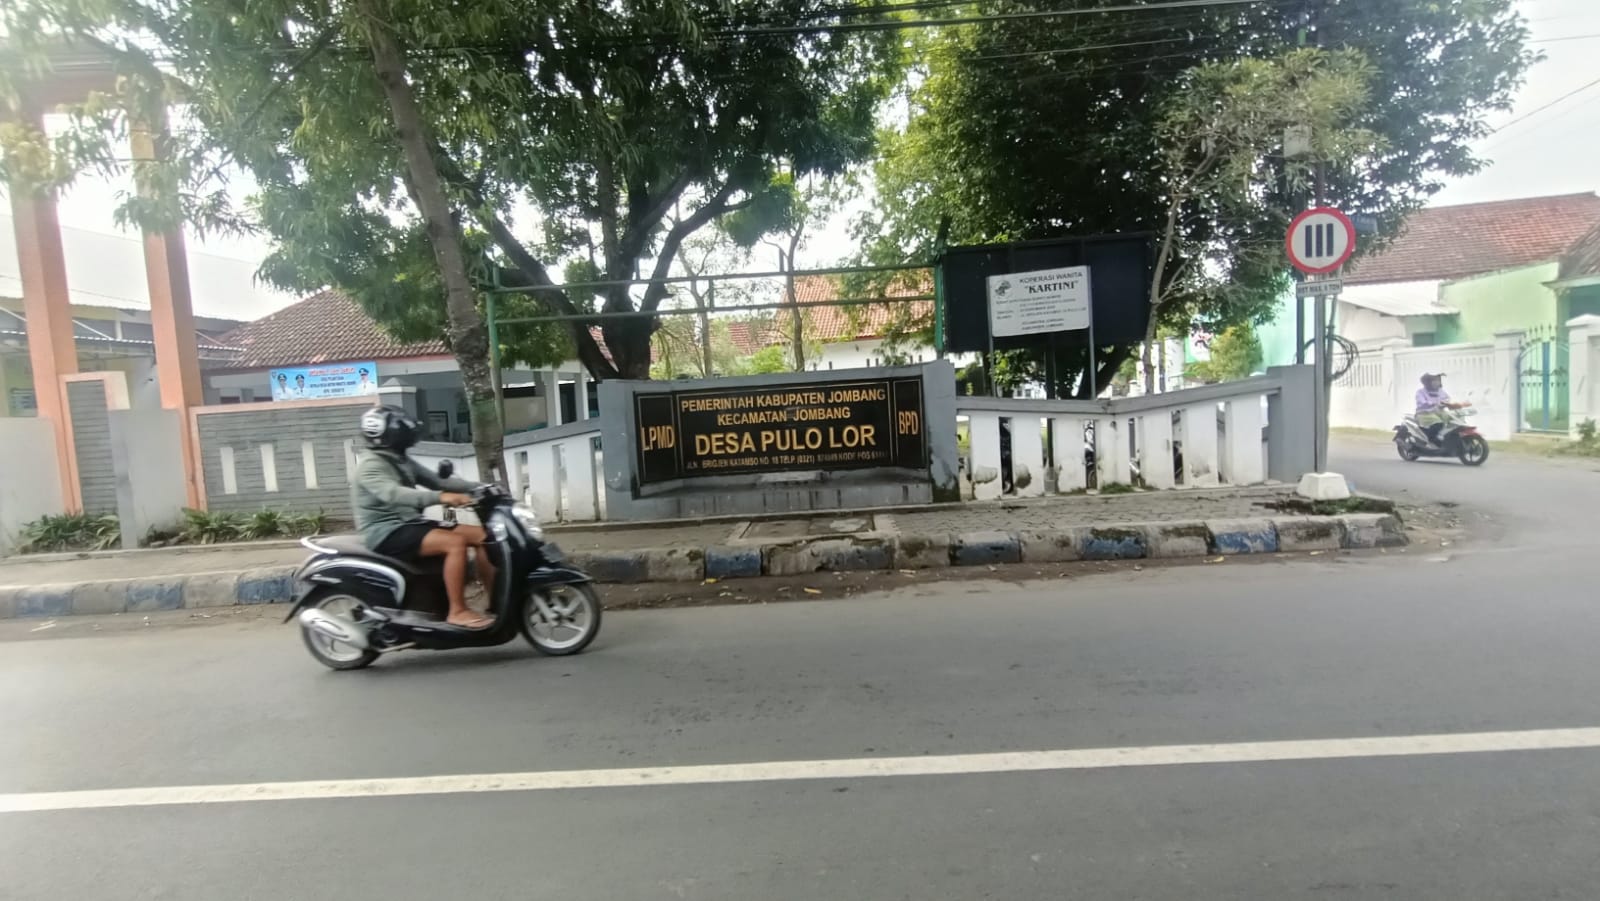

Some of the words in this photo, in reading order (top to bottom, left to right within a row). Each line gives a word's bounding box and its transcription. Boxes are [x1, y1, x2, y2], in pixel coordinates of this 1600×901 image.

[1020, 274, 1055, 284] KOPERASI
[1056, 271, 1083, 280] WANITA
[681, 397, 754, 412] PEMERINTAH
[756, 391, 825, 408] KABUPATEN
[827, 388, 886, 404] JOMBANG
[717, 410, 788, 426] KECAMATAN
[792, 407, 851, 421] JOMBANG
[898, 411, 919, 435] BPD
[641, 425, 675, 451] LPMD
[695, 431, 756, 456] DESA
[760, 426, 822, 452] PULO
[829, 424, 876, 448] LOR
